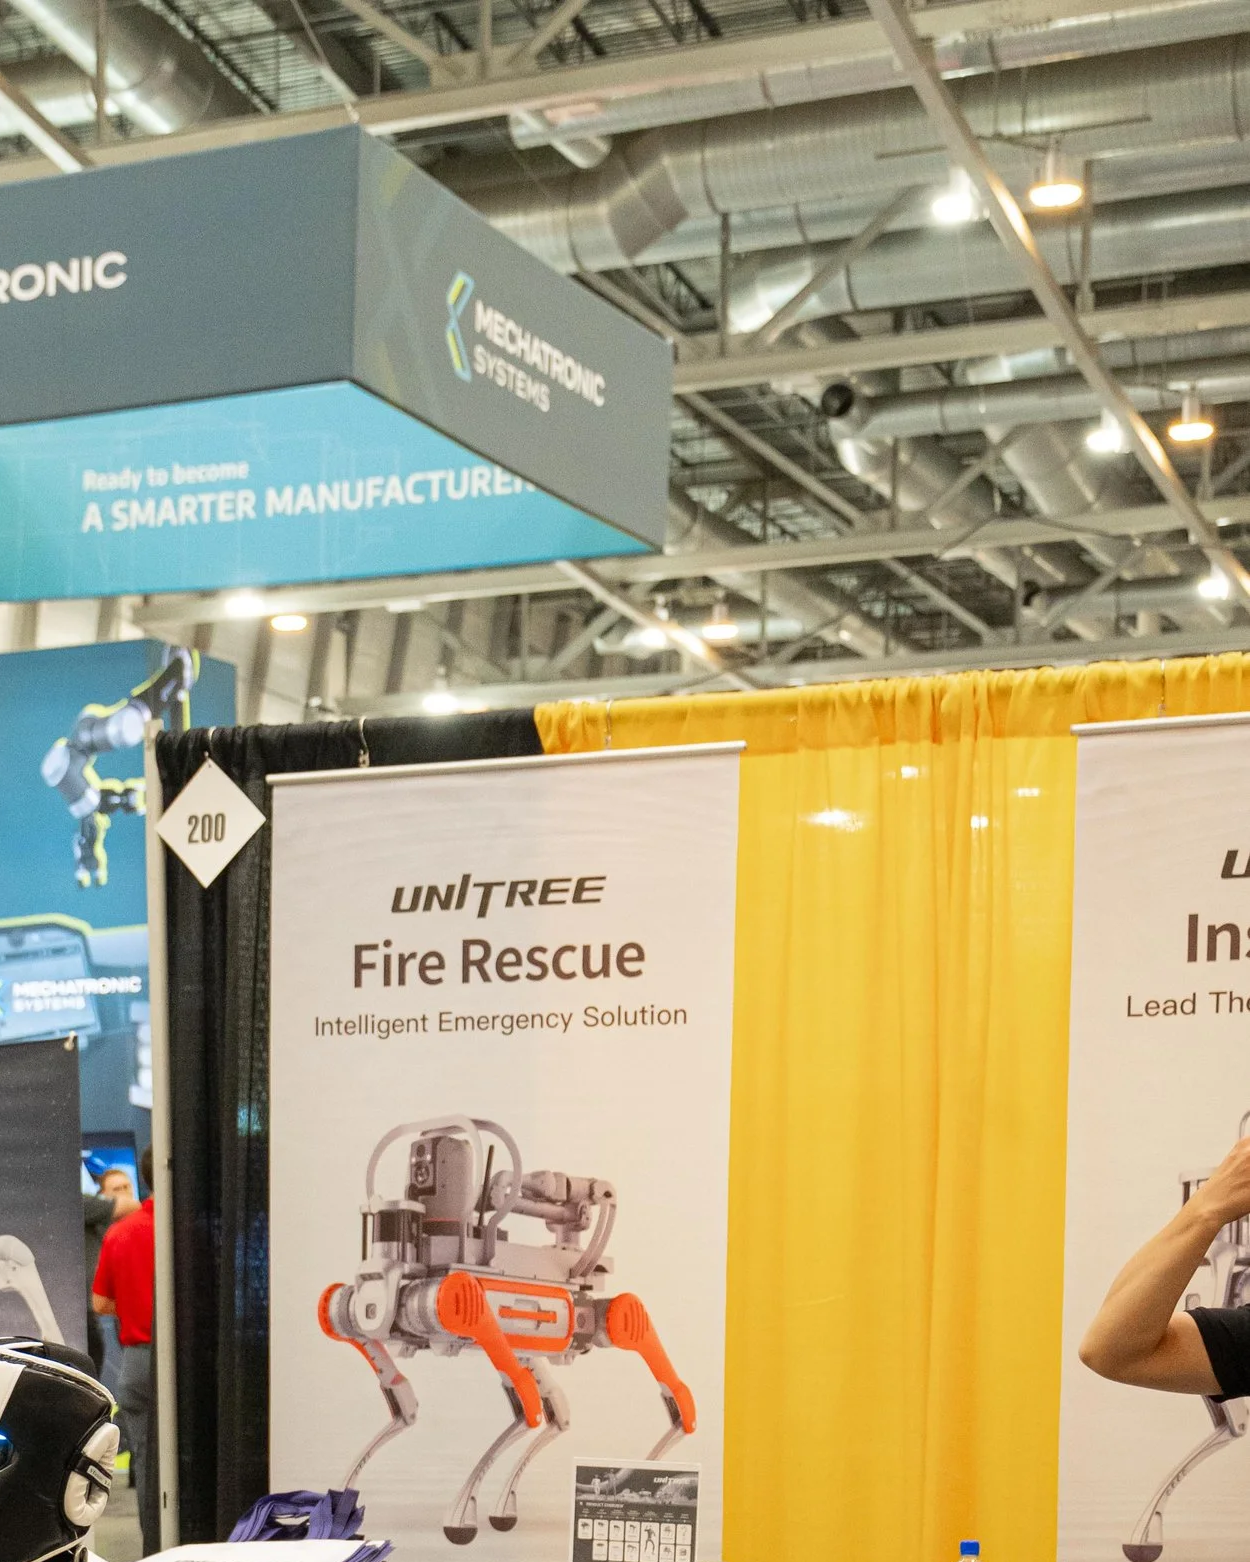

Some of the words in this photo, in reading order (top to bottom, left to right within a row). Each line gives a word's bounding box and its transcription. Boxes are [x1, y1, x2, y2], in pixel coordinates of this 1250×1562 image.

[473, 298, 606, 407] MECHATRONIC
[472, 343, 551, 413] SYSTEMS
[82, 468, 143, 493] Ready
[147, 464, 169, 487] to
[172, 460, 250, 485] become
[81, 501, 104, 533] A
[110, 489, 257, 532] SMARTER
[187, 812, 227, 844] 200
[390, 872, 607, 918] UNITREE
[1186, 913, 1250, 964] In
[353, 939, 446, 989] Fire
[461, 936, 646, 984] Rescue
[11, 975, 143, 998] MECHATRONIC
[11, 995, 87, 1013] SYSTEMS
[1126, 993, 1197, 1018] Lead
[314, 1014, 429, 1040] Intelligent
[437, 1007, 574, 1036] Emergency
[582, 1003, 688, 1028] Solution
